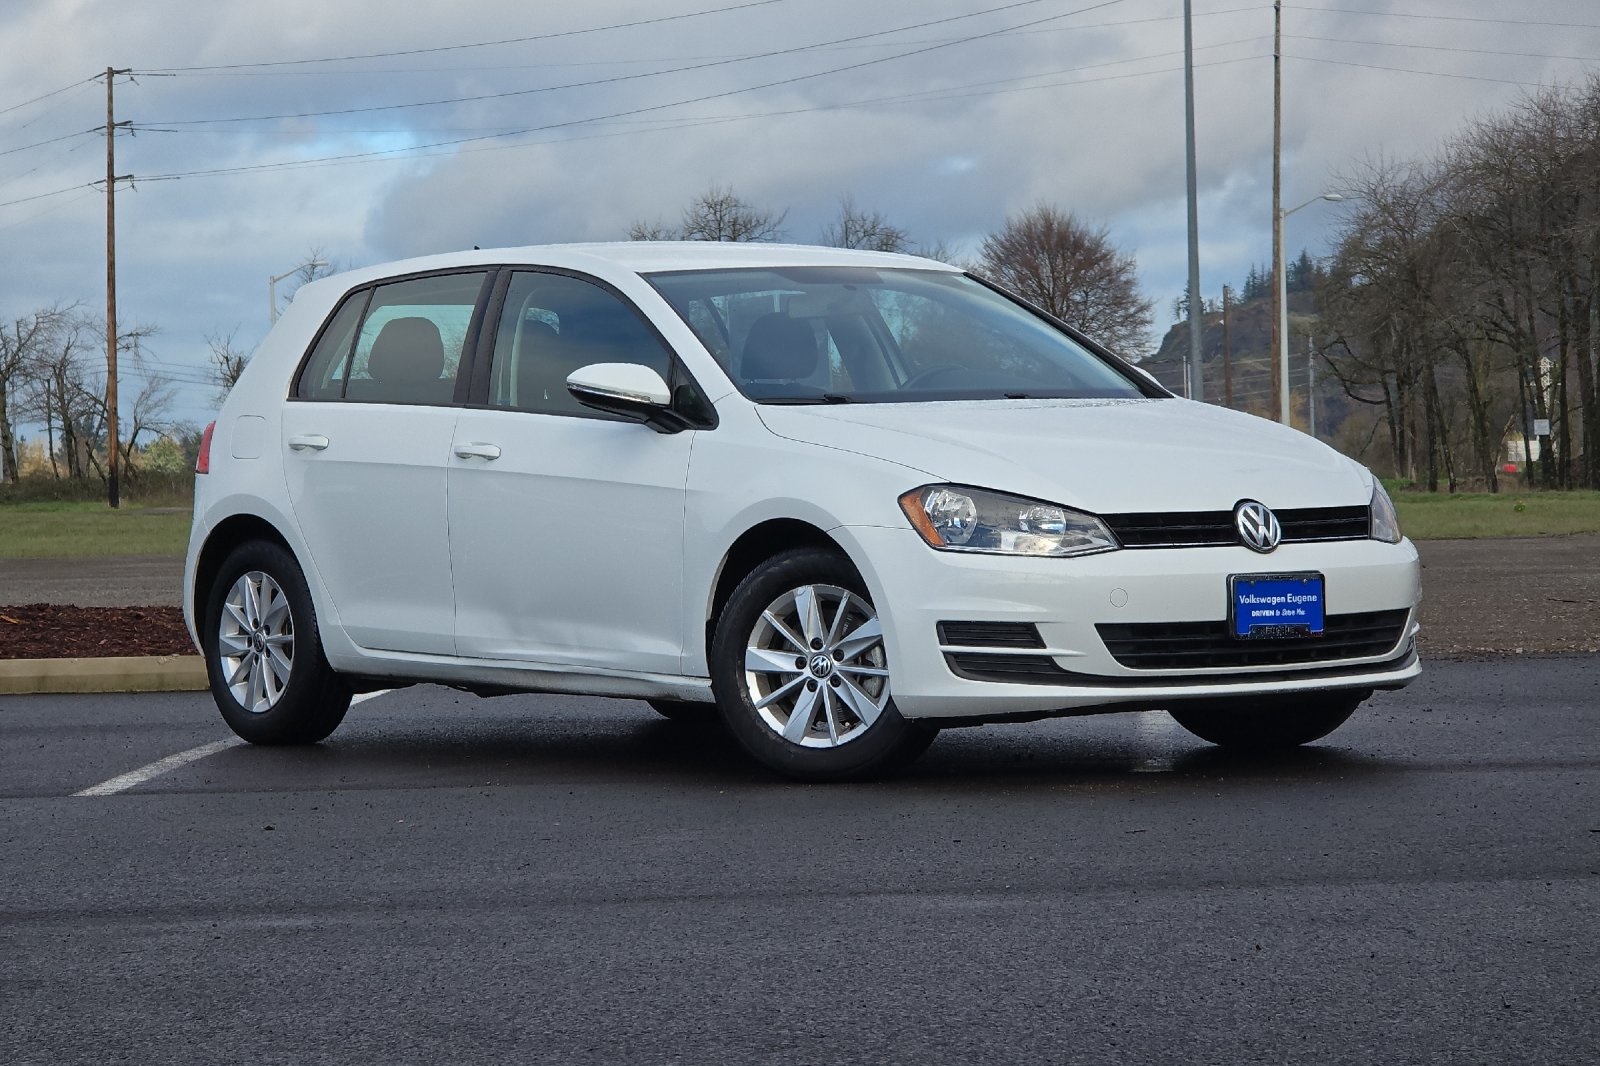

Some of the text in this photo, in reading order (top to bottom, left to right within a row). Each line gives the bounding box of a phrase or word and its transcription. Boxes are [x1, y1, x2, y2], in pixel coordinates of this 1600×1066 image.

[1237, 502, 1281, 550] VW
[1239, 593, 1318, 605] Volkswagen Eugene
[1251, 609, 1275, 617] DRIVEN
